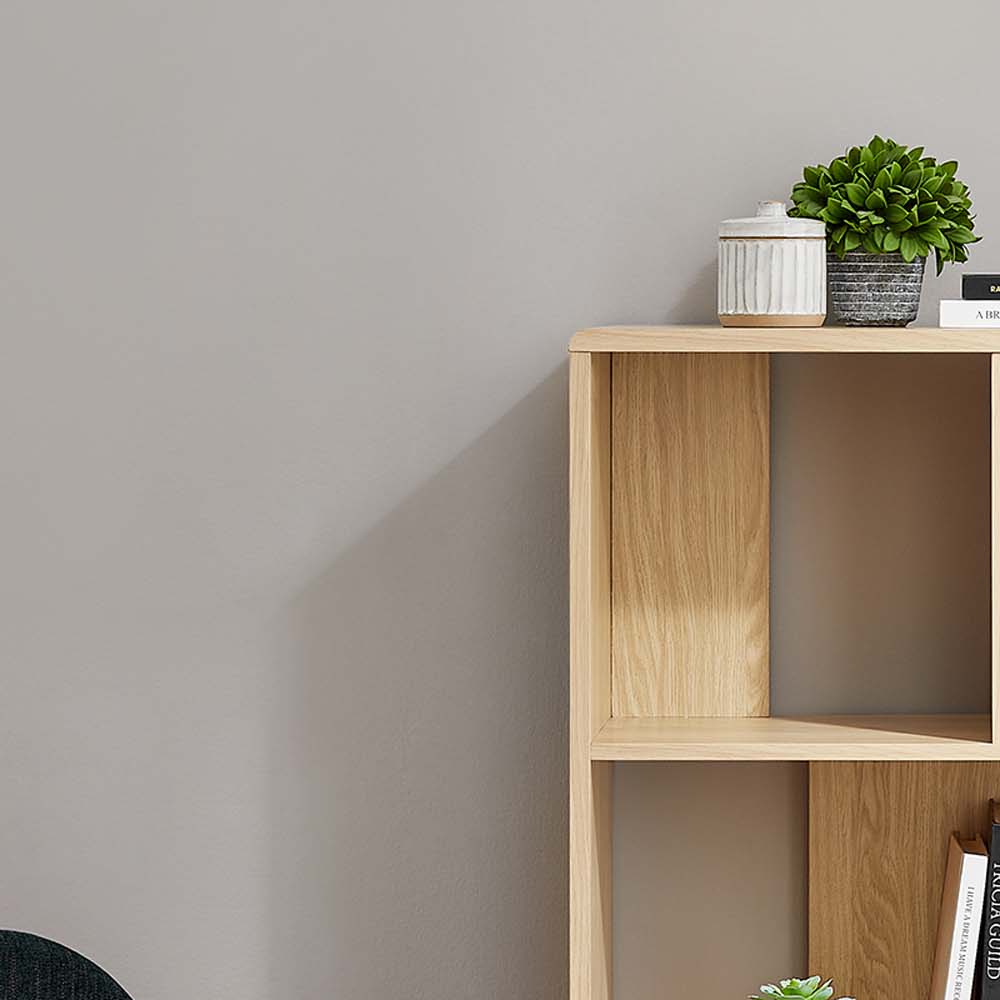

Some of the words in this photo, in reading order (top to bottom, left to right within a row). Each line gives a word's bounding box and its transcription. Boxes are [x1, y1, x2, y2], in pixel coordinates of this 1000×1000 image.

[976, 310, 984, 320] A
[964, 891, 974, 912] HAVE
[959, 922, 970, 952] DREAM
[955, 953, 966, 980] MUSIC
